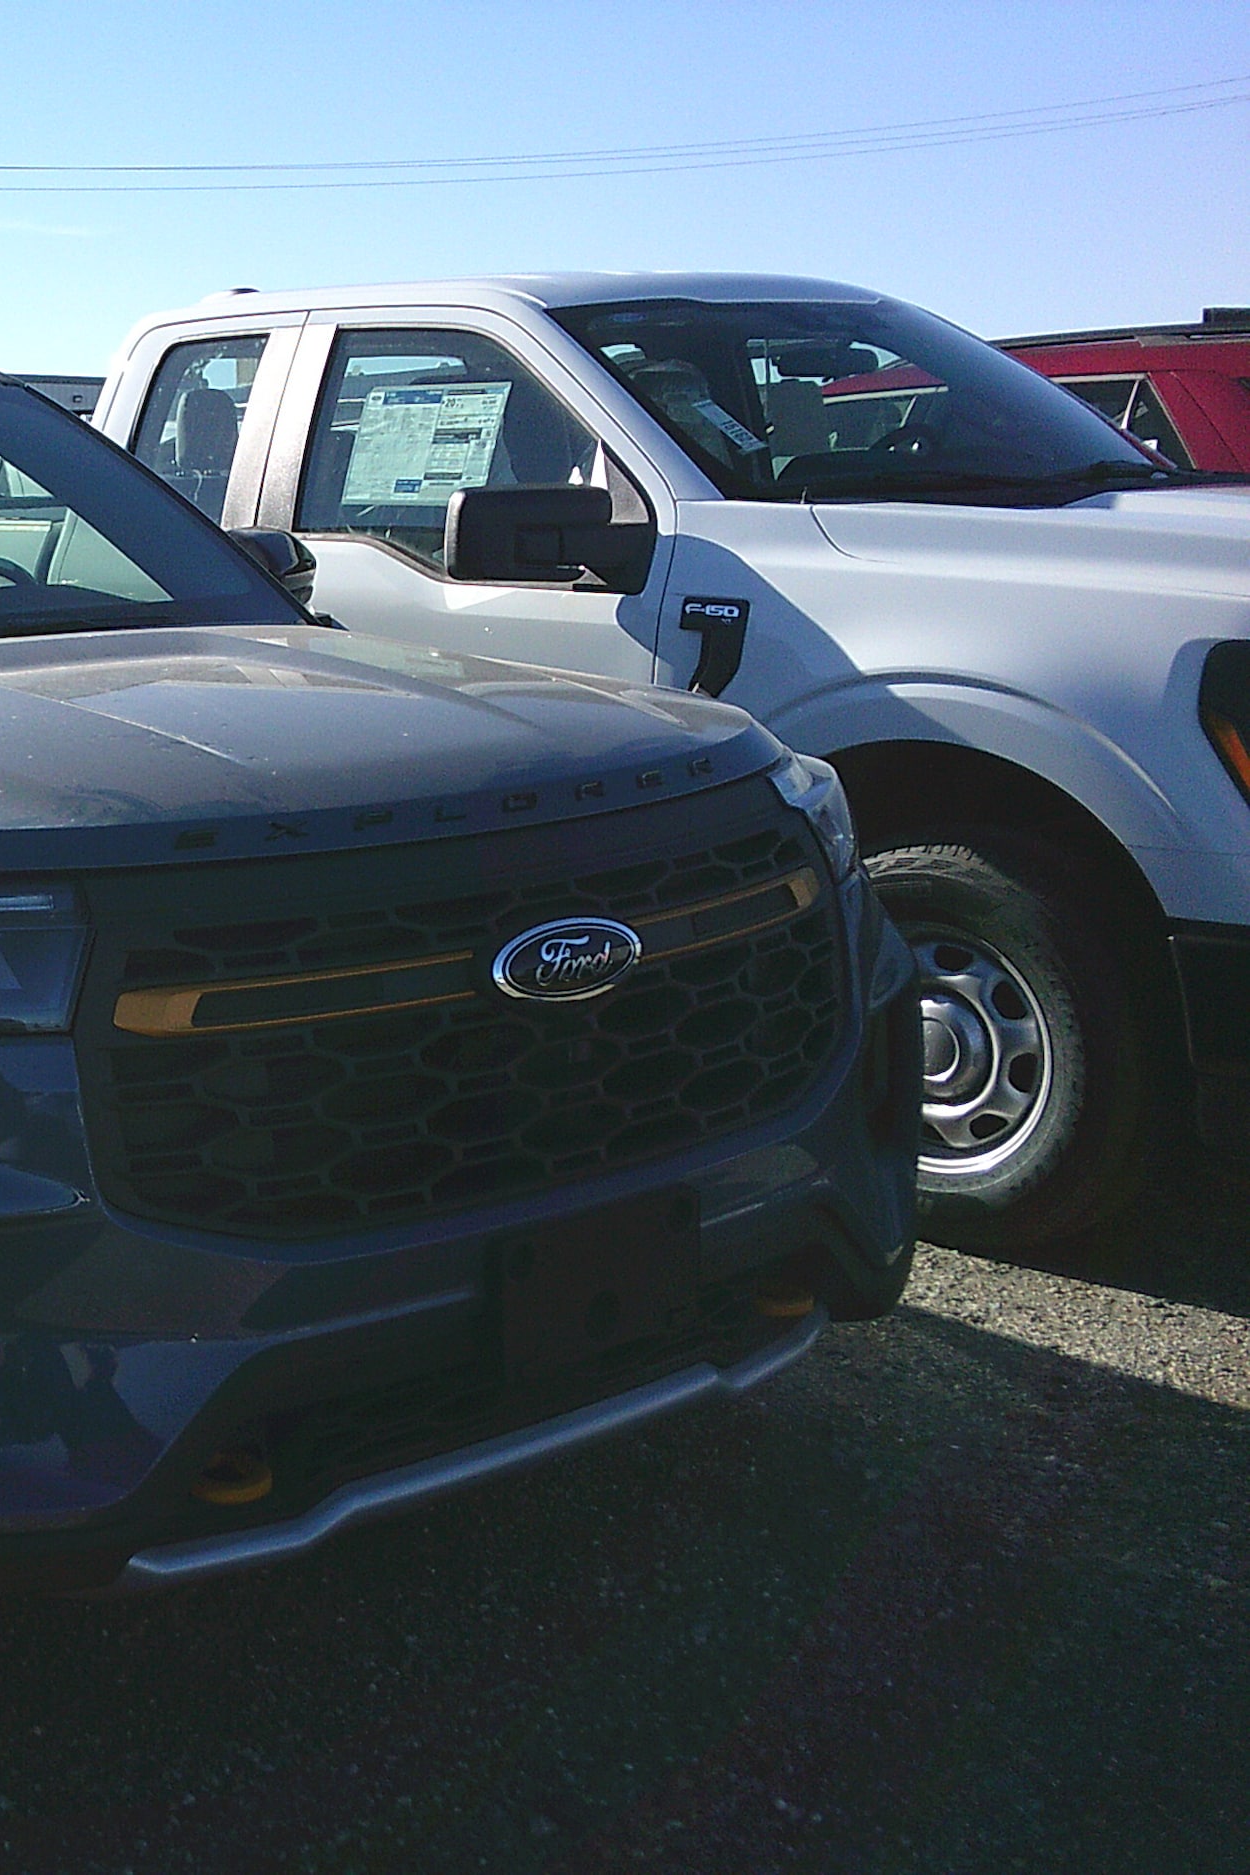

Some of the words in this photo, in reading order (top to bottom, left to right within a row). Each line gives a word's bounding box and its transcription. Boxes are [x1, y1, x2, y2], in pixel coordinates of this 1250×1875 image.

[684, 602, 740, 618] F-150
[173, 756, 714, 850] EXPLORER
[535, 934, 614, 987] Ford
